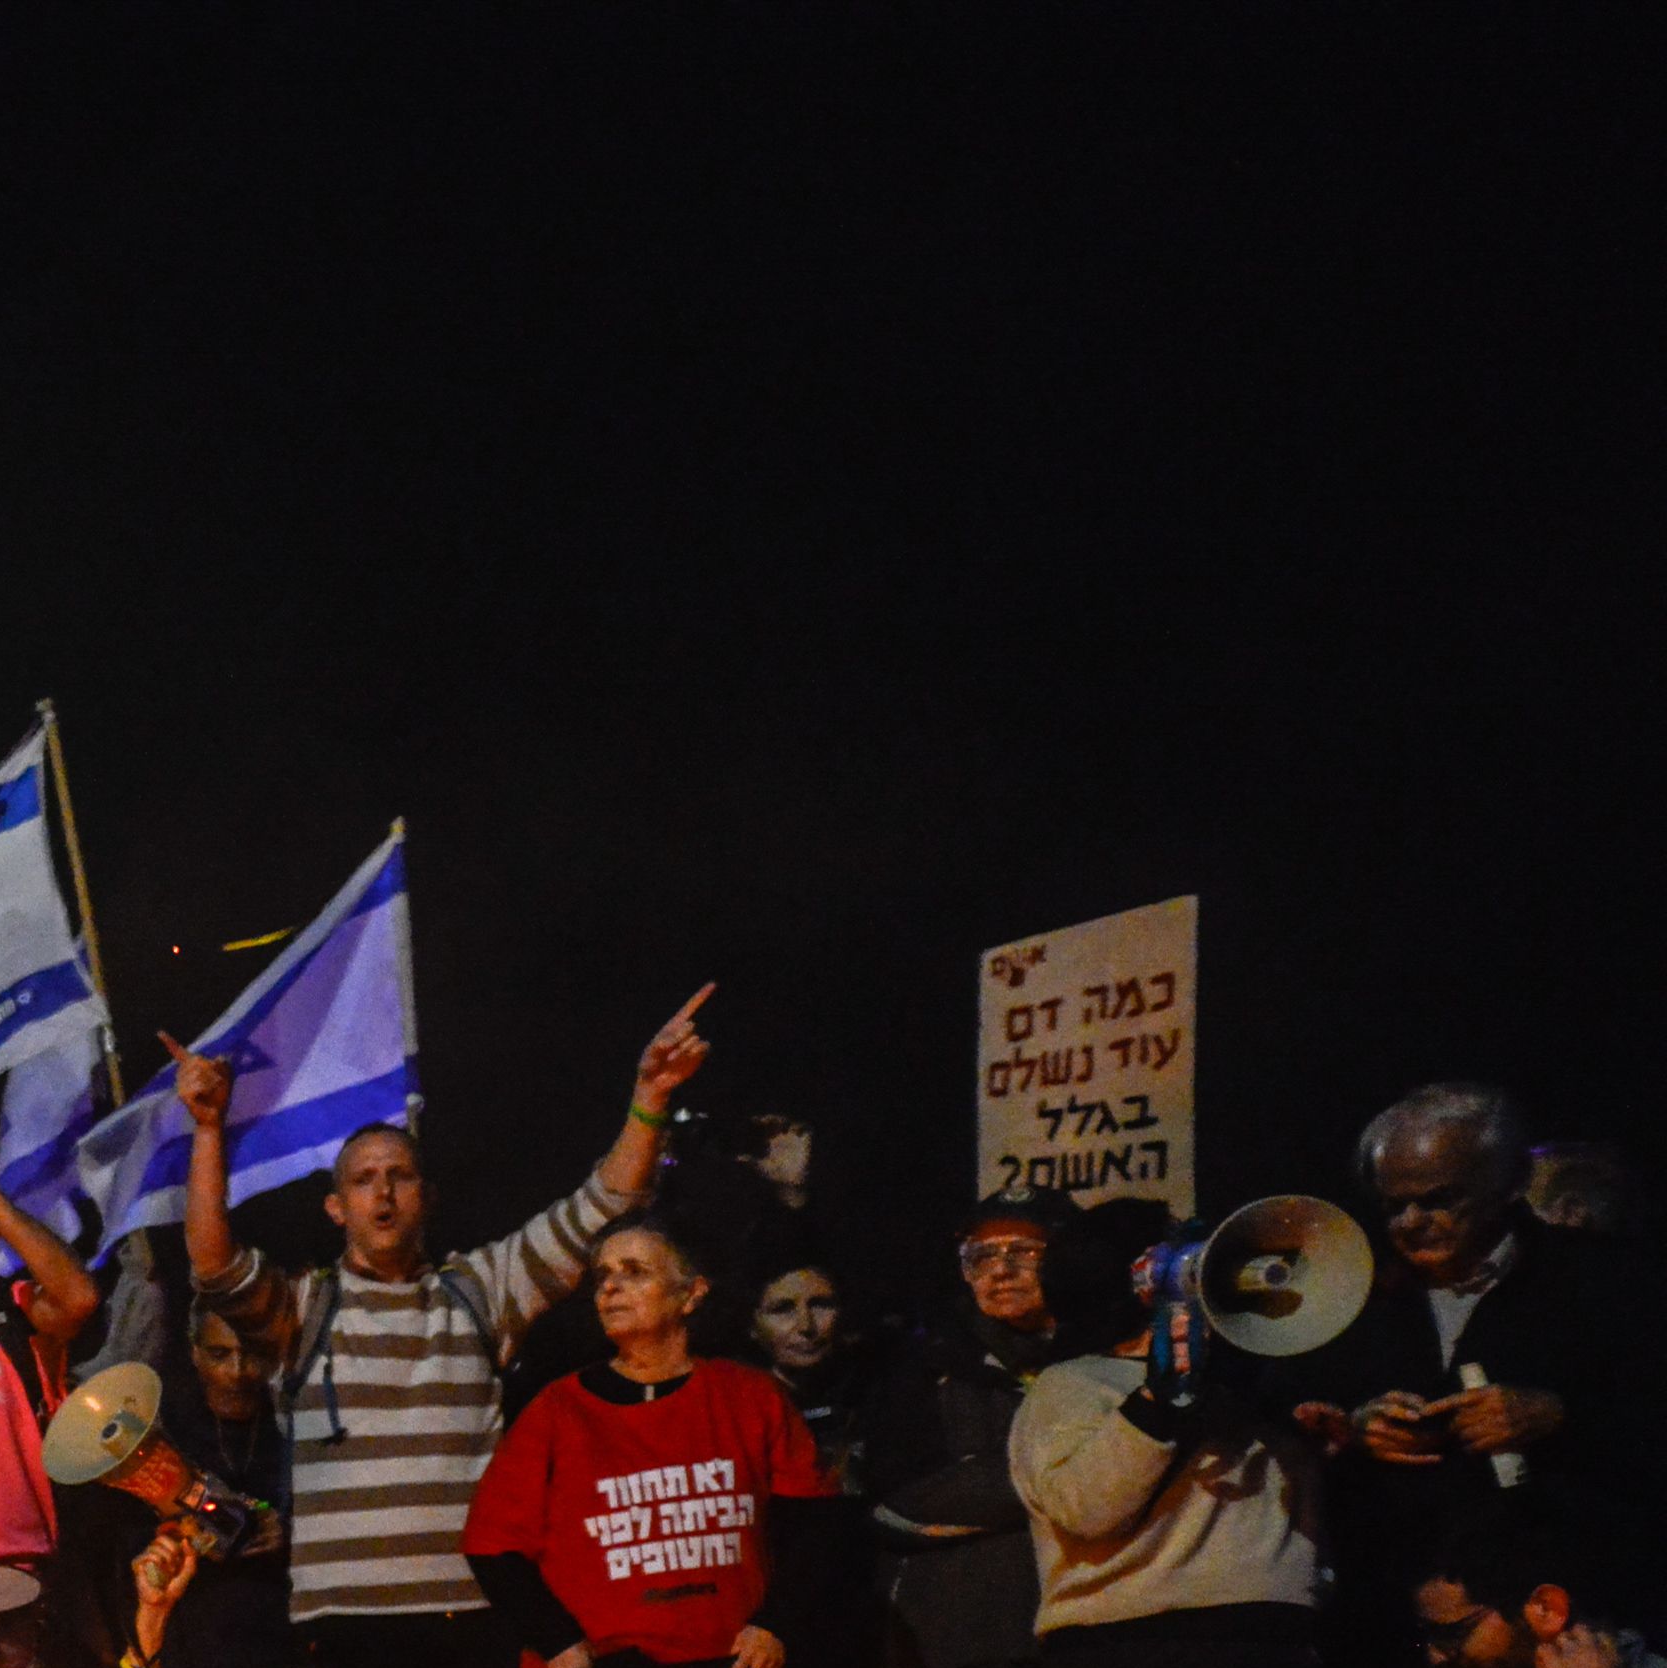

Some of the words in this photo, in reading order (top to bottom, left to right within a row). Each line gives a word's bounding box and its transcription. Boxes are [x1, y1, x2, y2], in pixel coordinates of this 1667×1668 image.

[1005, 995, 1064, 1042] דם
[1082, 971, 1176, 1025] כמה
[987, 1046, 1095, 1098] נשלם
[1108, 1028, 1182, 1071] עוד
[1036, 1093, 1159, 1140] בגלל
[998, 1140, 1168, 1189] האשם?
[596, 1465, 689, 1509] תחזור
[691, 1457, 735, 1494] לא
[583, 1505, 653, 1547] לפני
[659, 1493, 756, 1536] הביתה
[606, 1532, 742, 1581] החטופים
